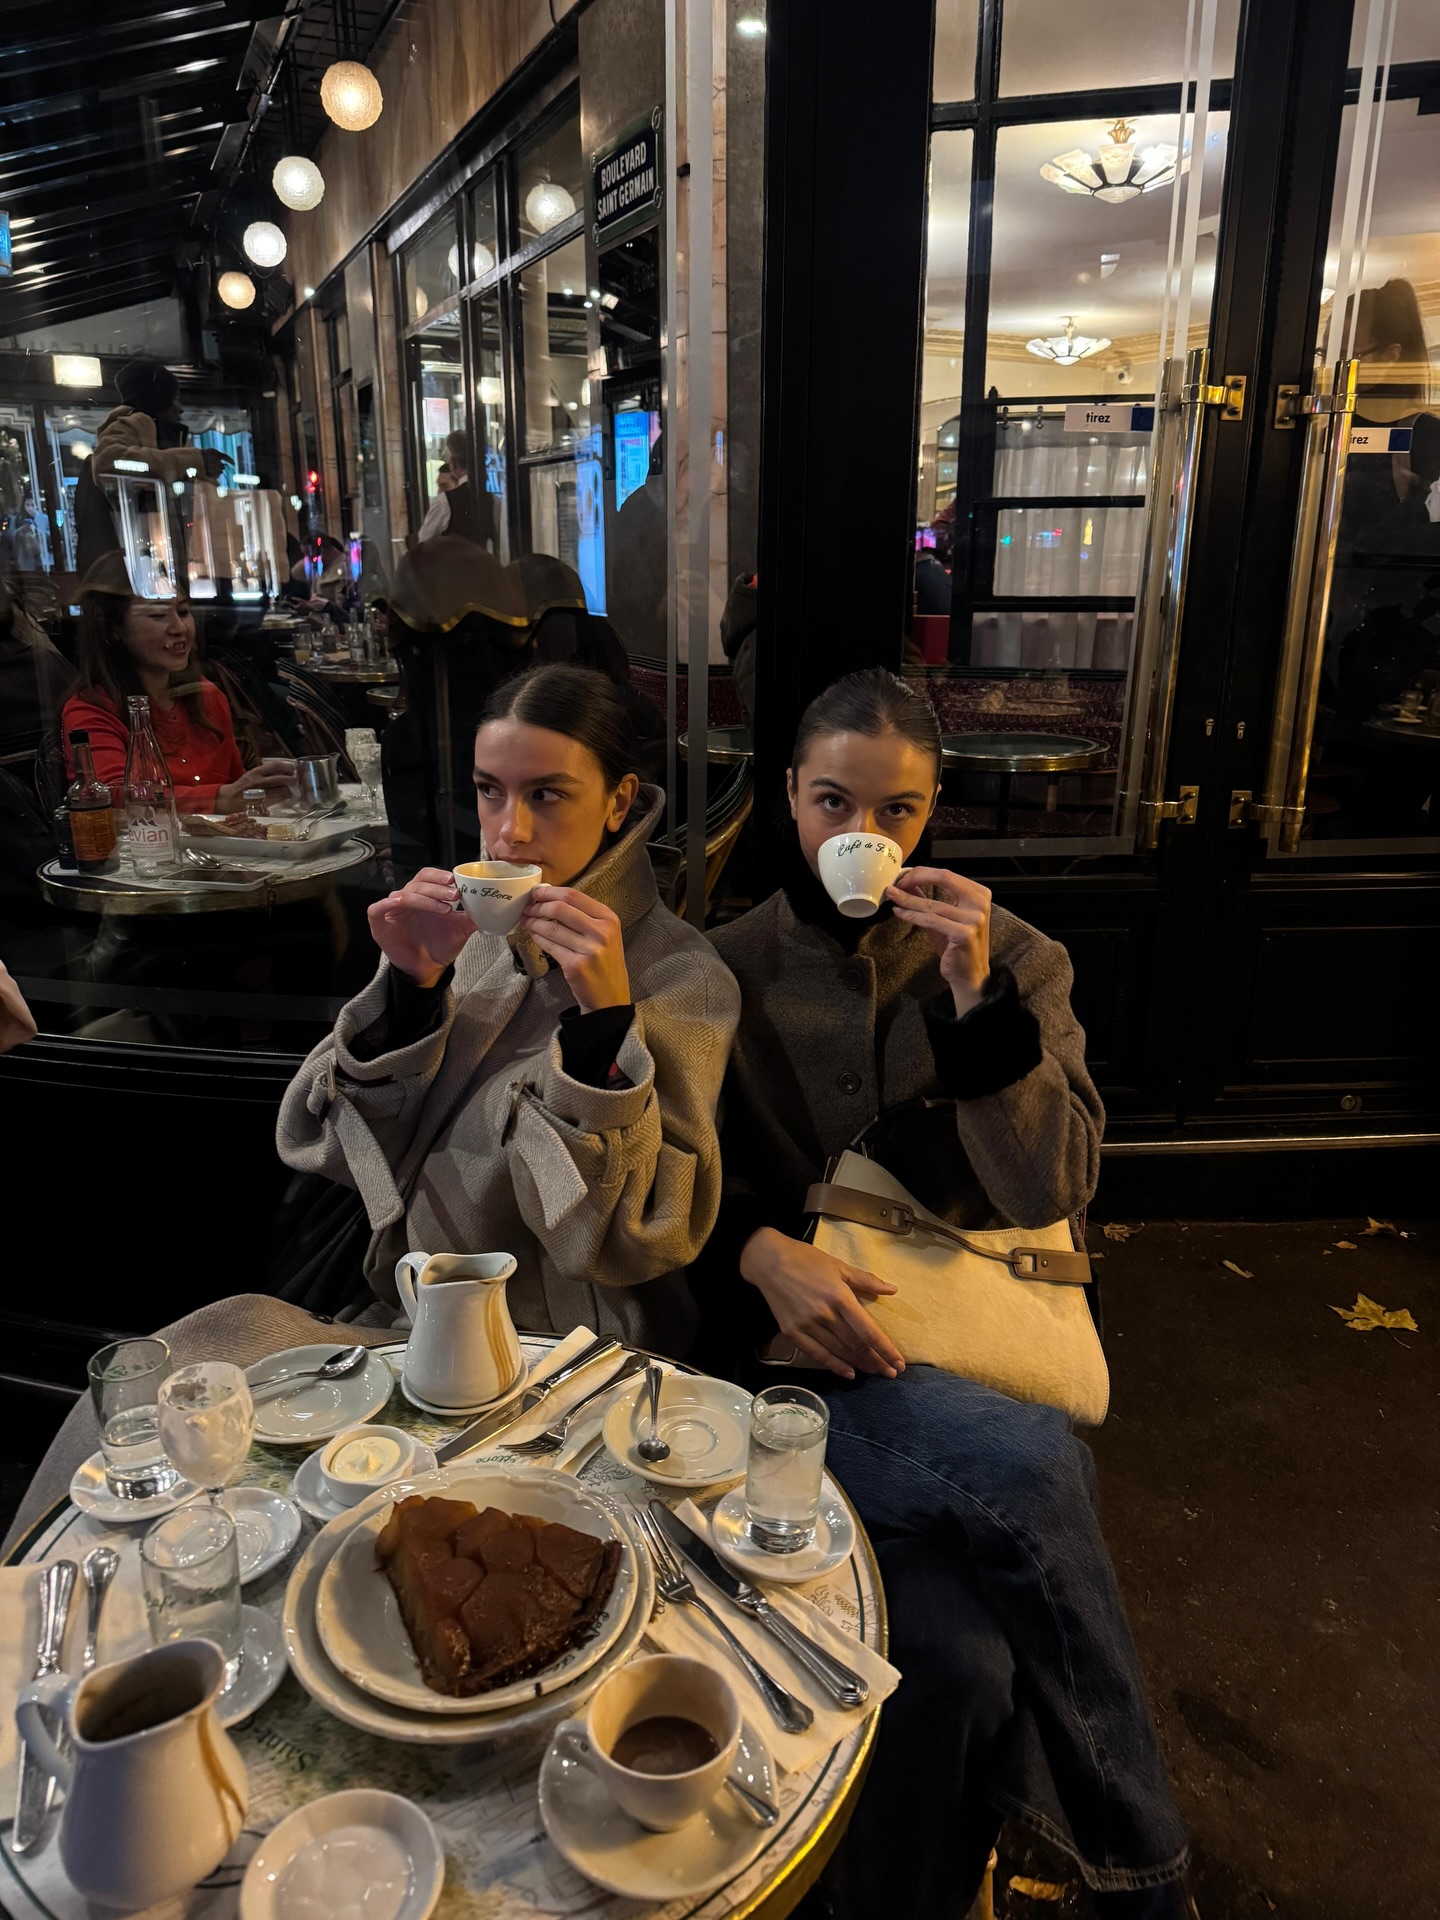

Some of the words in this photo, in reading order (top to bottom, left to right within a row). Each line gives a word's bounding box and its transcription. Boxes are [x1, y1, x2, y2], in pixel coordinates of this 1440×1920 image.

[601, 141, 647, 191] BOULEVARD
[597, 188, 618, 221] SAINT
[618, 166, 654, 208] GERMAIN
[1085, 412, 1111, 424] tirez
[1349, 433, 1369, 445] irez
[129, 828, 169, 843] evian
[837, 840, 863, 857] Café
[480, 886, 513, 901] Flore
